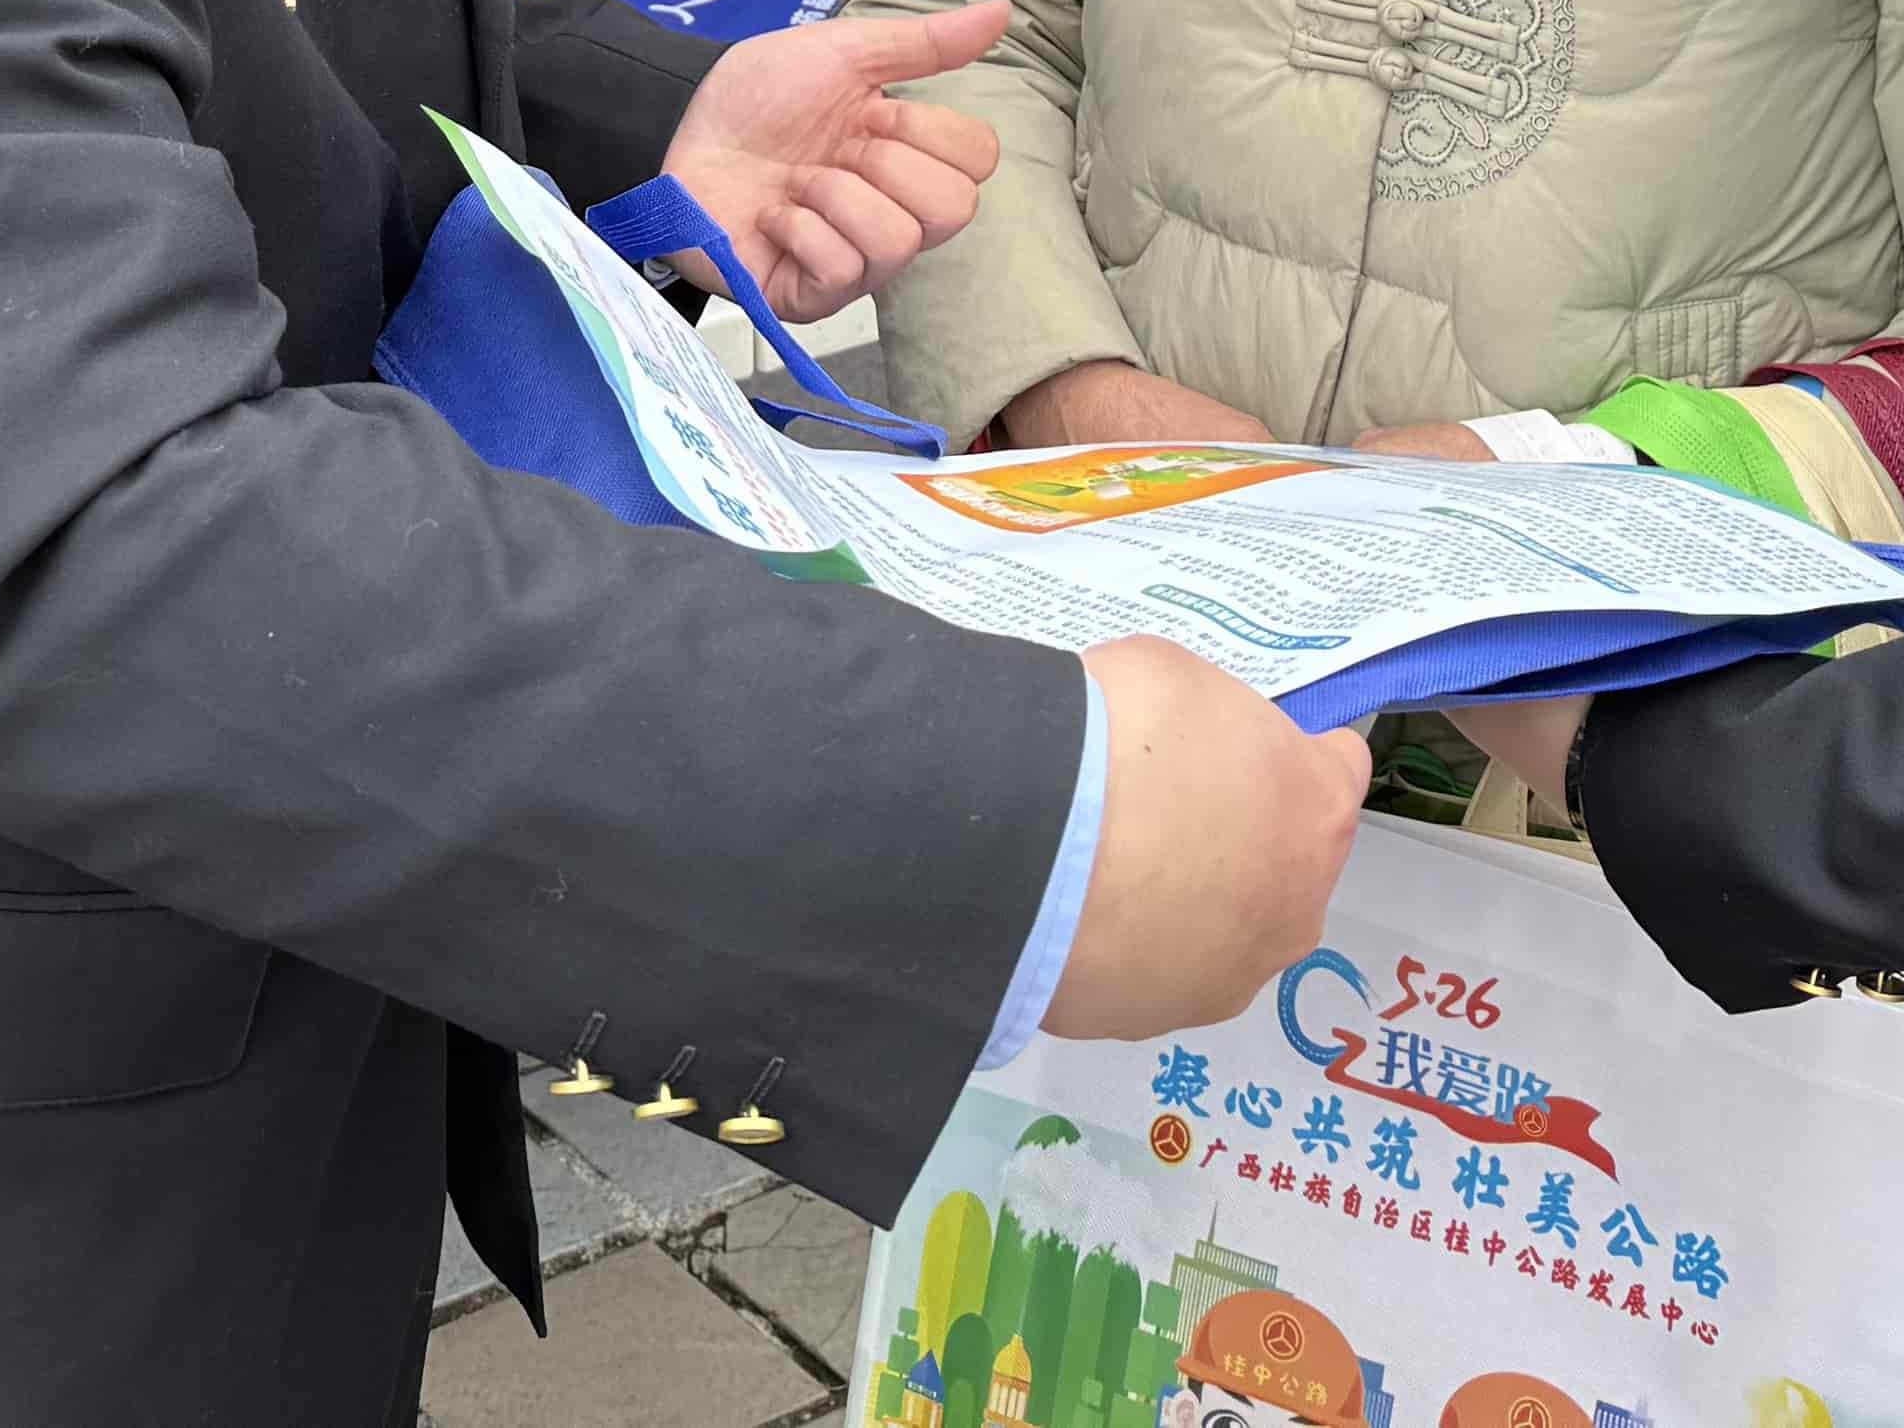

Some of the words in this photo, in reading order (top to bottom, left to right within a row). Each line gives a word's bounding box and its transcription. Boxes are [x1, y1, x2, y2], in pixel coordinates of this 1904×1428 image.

[1375, 1026, 1553, 1126] 我爱路
[1151, 1044, 1422, 1192] 凝心共筑
[1451, 1147, 1730, 1300] 壮美公路
[1200, 1138, 1720, 1346] 广西壮族自治区桂中公路发展中心
[1223, 1351, 1329, 1407] 桂中公路
